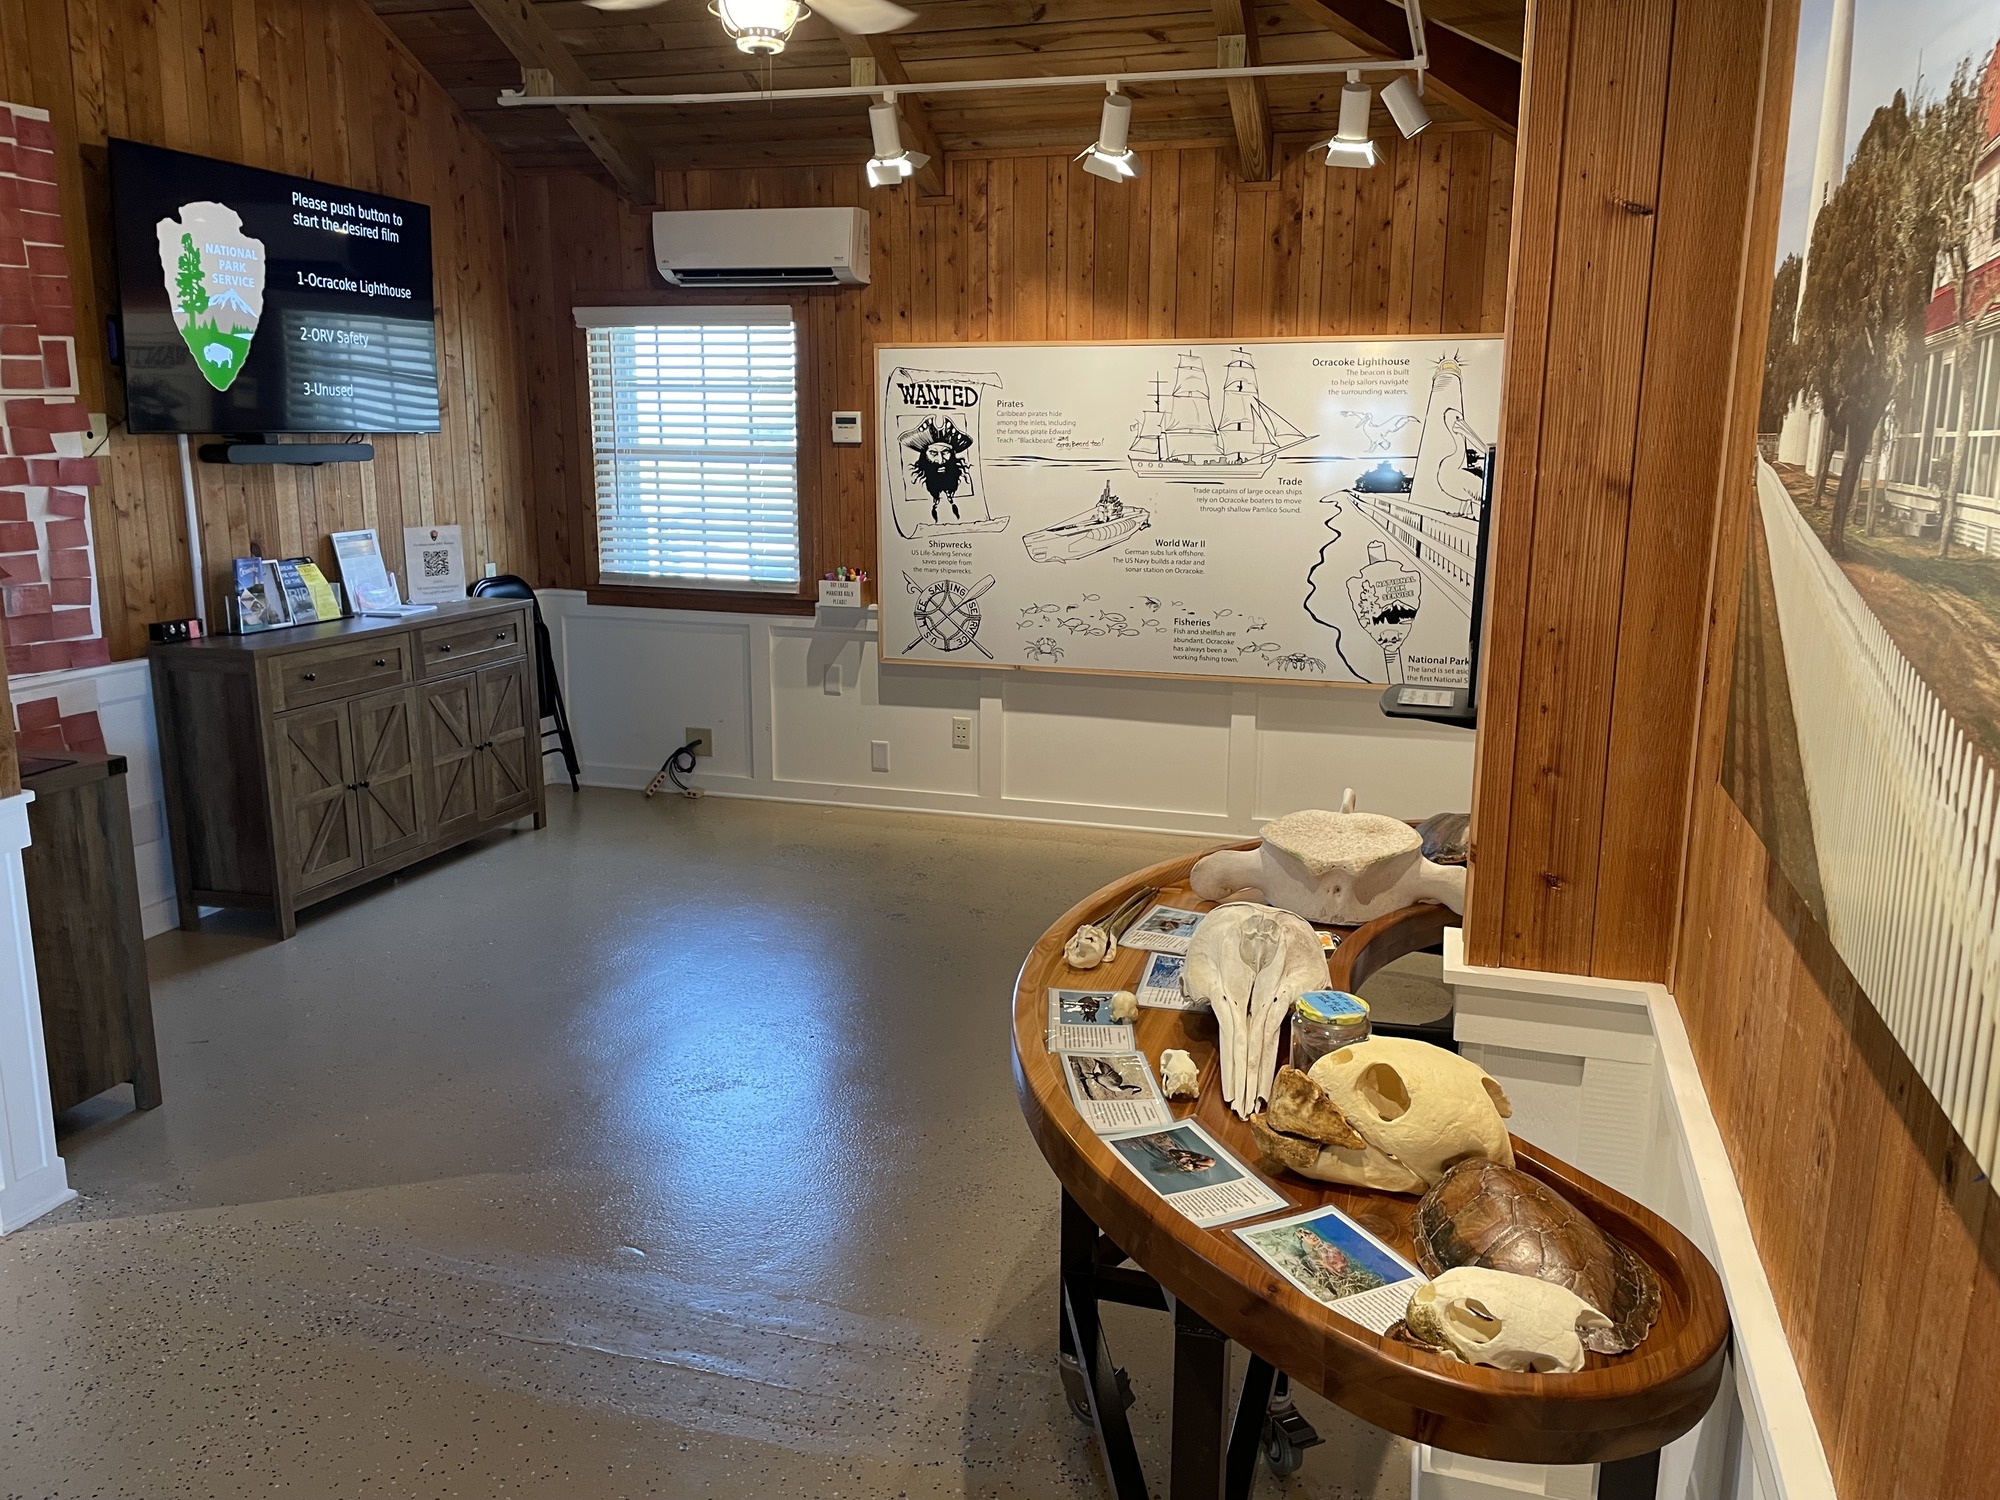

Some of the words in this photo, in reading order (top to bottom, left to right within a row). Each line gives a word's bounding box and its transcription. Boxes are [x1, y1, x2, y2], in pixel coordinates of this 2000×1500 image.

[292, 192, 327, 212] Please
[330, 202, 355, 219] push
[358, 205, 390, 224] button
[393, 213, 402, 226] to
[293, 213, 319, 228] start
[322, 216, 339, 232] the
[342, 222, 378, 239] desired
[381, 228, 399, 243] film
[205, 243, 258, 260] NATIONAL
[219, 260, 246, 273] PARK
[212, 273, 255, 288] SERVICE
[297, 272, 357, 292] 1-Ocracoke
[360, 280, 412, 299] Lighthouse
[300, 327, 334, 343] 2-ORV
[337, 331, 369, 348] Safety
[1312, 357, 1355, 366] Ocracoke
[1357, 357, 1410, 368] Lighthouse
[1339, 378, 1356, 386] help
[1379, 378, 1409, 386] navigate
[303, 382, 353, 397] 3-Unused
[1340, 388, 1383, 396] surrounding
[897, 383, 978, 407] WANTED
[996, 399, 1024, 408] Pirates
[1048, 419, 1076, 428] including
[1277, 477, 1303, 486] Trade
[1247, 488, 1263, 496] large
[1196, 496, 1207, 504] rely
[1199, 505, 1226, 514] through
[928, 540, 972, 550] Shipwrecks
[1155, 539, 1180, 547] World
[1181, 539, 1198, 548] War
[920, 549, 951, 558] Life-Saving
[1134, 557, 1150, 565] Navy
[1376, 576, 1416, 588] NATIONAL
[1386, 584, 1406, 593] PARK
[1382, 590, 1414, 601] SERVICE
[1174, 617, 1211, 627] Fisheries
[1172, 654, 1198, 662] working
[1199, 654, 1220, 663] fishing
[1408, 655, 1447, 664] National
[1450, 656, 1469, 666] Park
